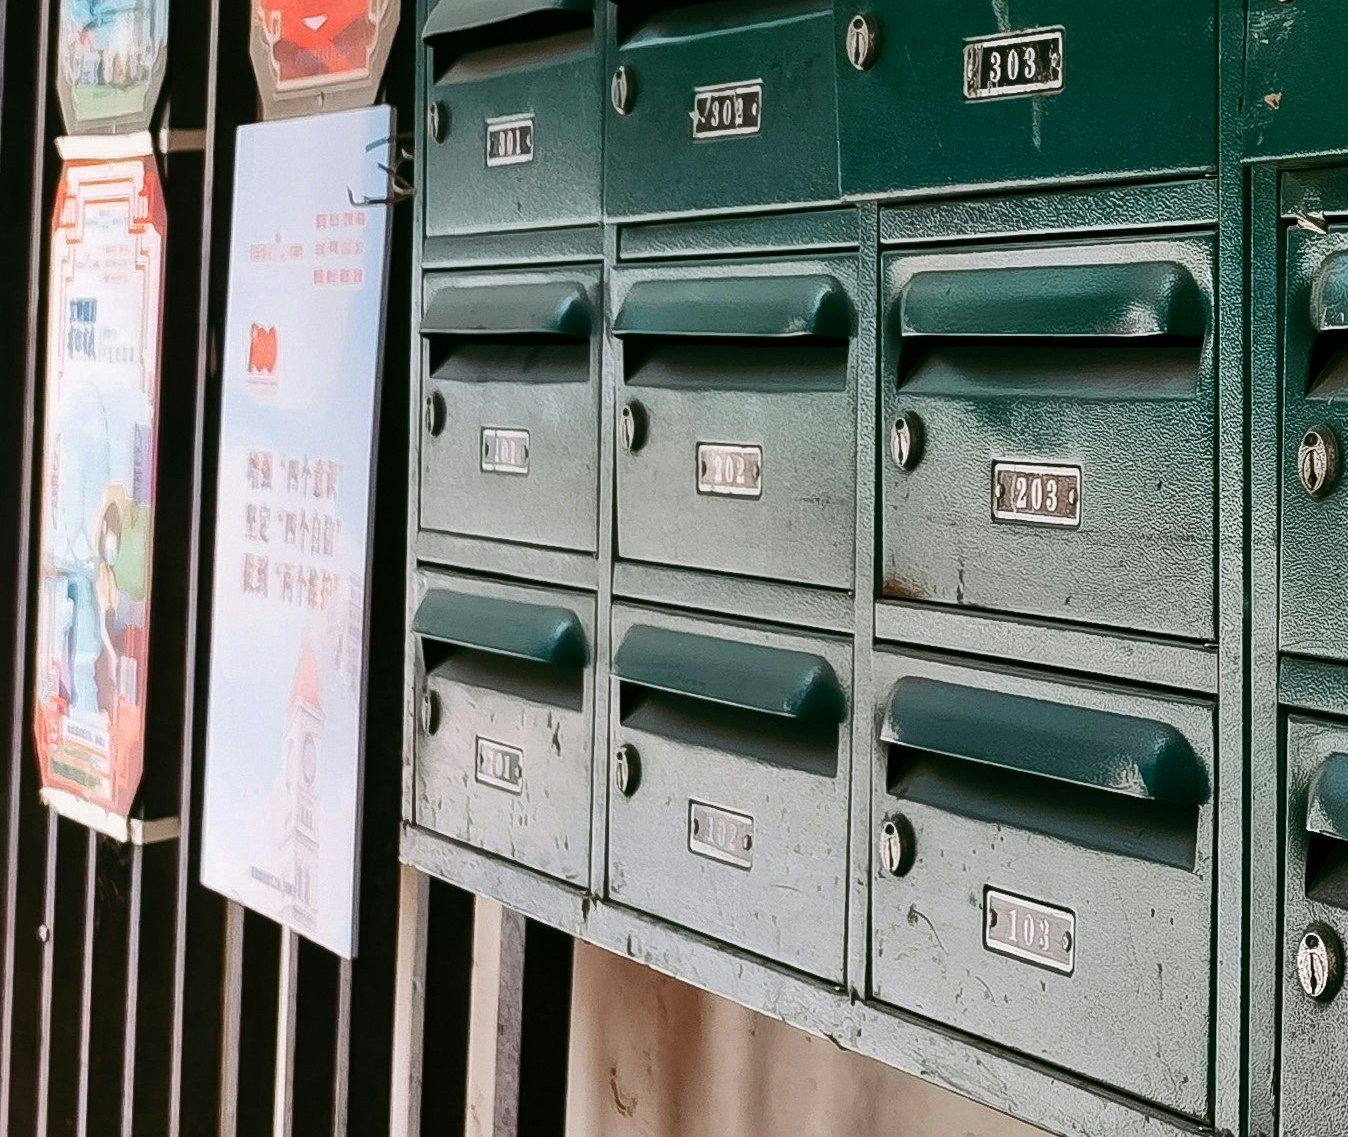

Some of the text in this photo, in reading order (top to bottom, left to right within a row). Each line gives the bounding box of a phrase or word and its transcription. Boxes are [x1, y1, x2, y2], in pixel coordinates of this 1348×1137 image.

[989, 47, 1037, 83] 303
[710, 97, 744, 127] 302
[1015, 476, 1058, 512] 203
[1006, 909, 1050, 951] 103
